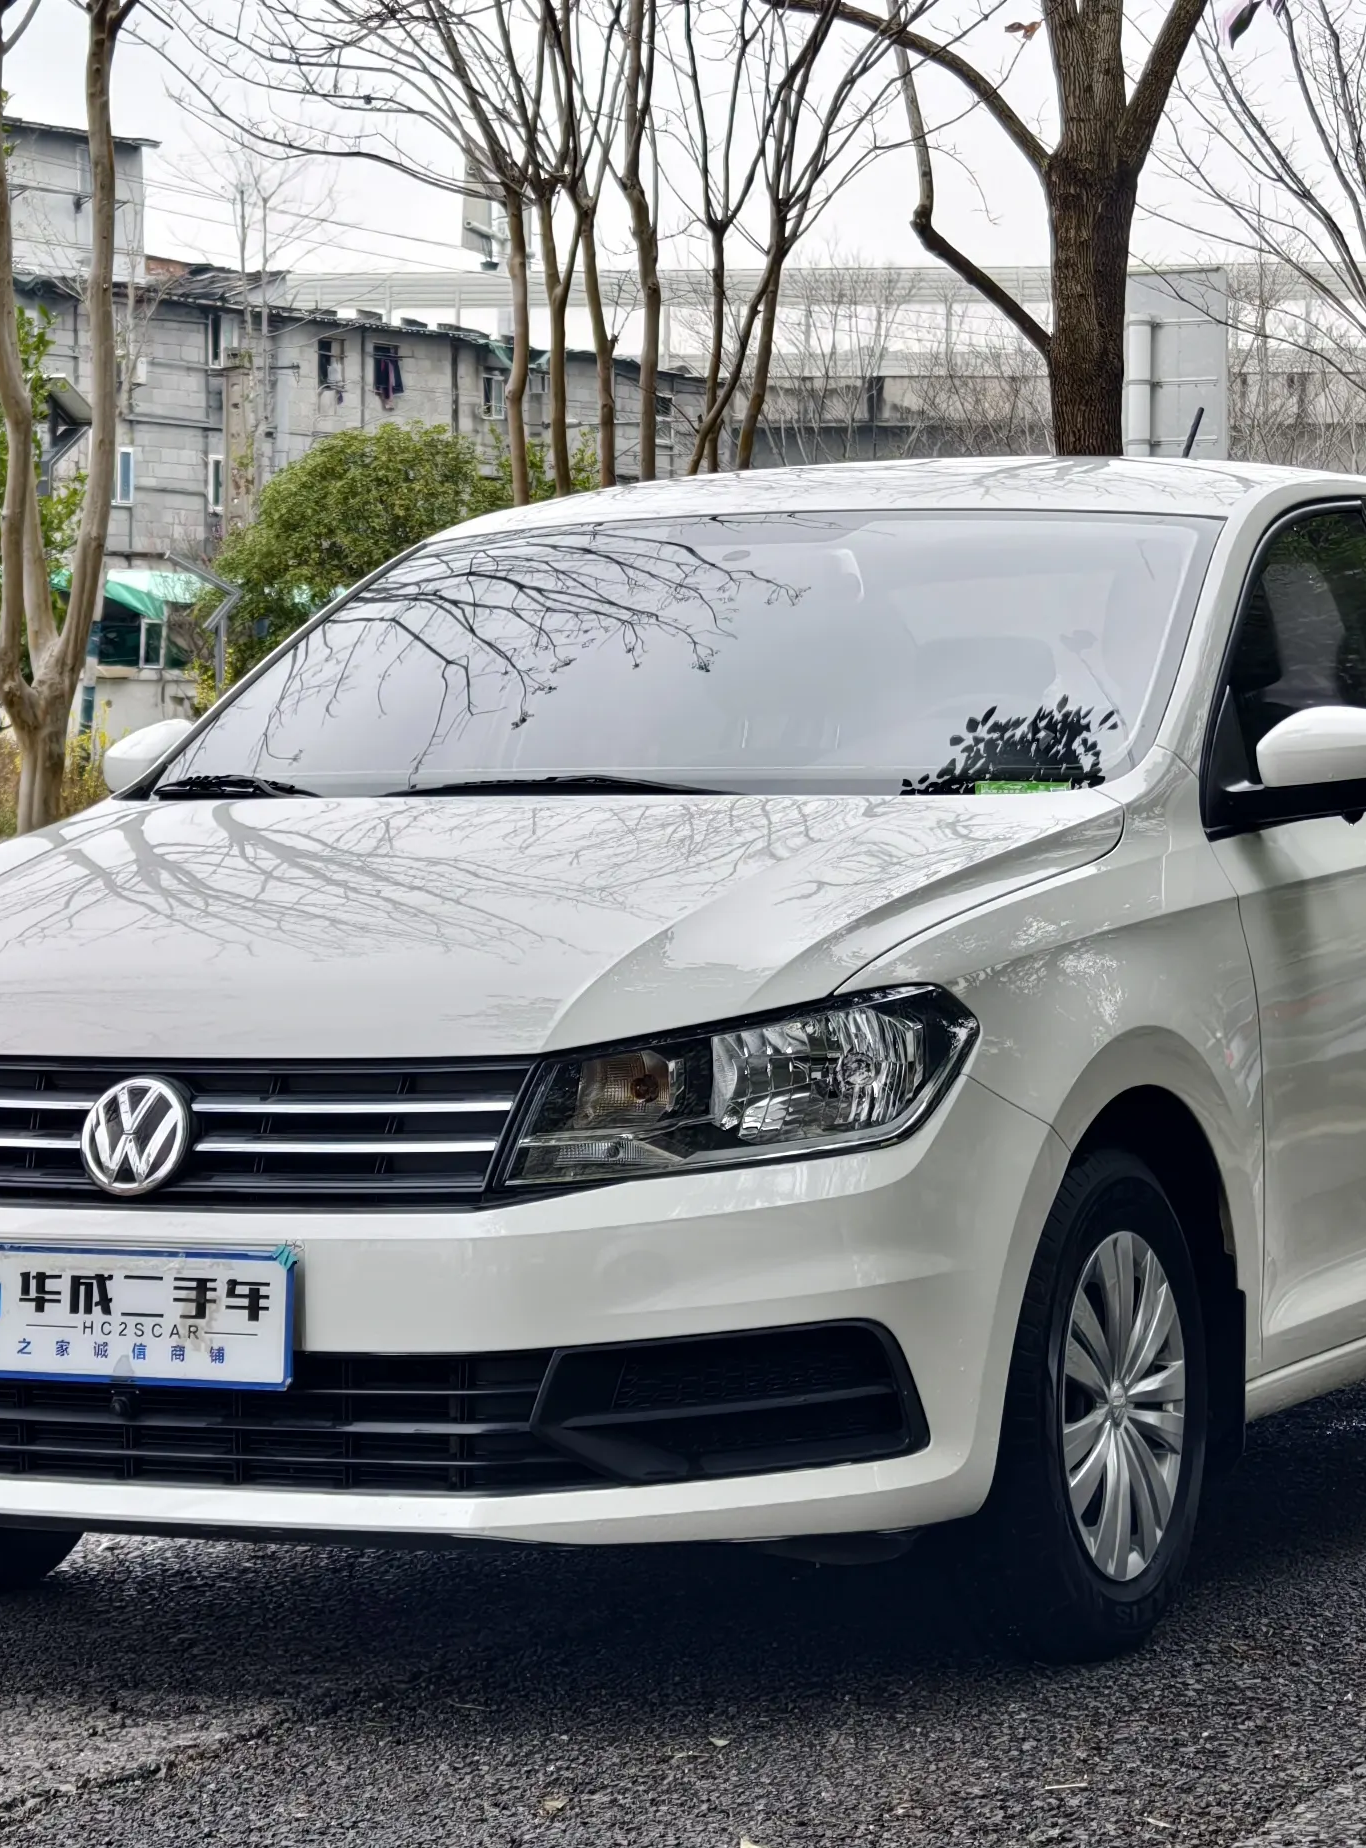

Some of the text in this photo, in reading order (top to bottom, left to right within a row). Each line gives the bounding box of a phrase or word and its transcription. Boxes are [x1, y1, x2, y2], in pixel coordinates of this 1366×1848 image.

[83, 1077, 187, 1190] VW
[19, 1271, 271, 1322] 华成二手车
[82, 1320, 200, 1340] HC2SCAR
